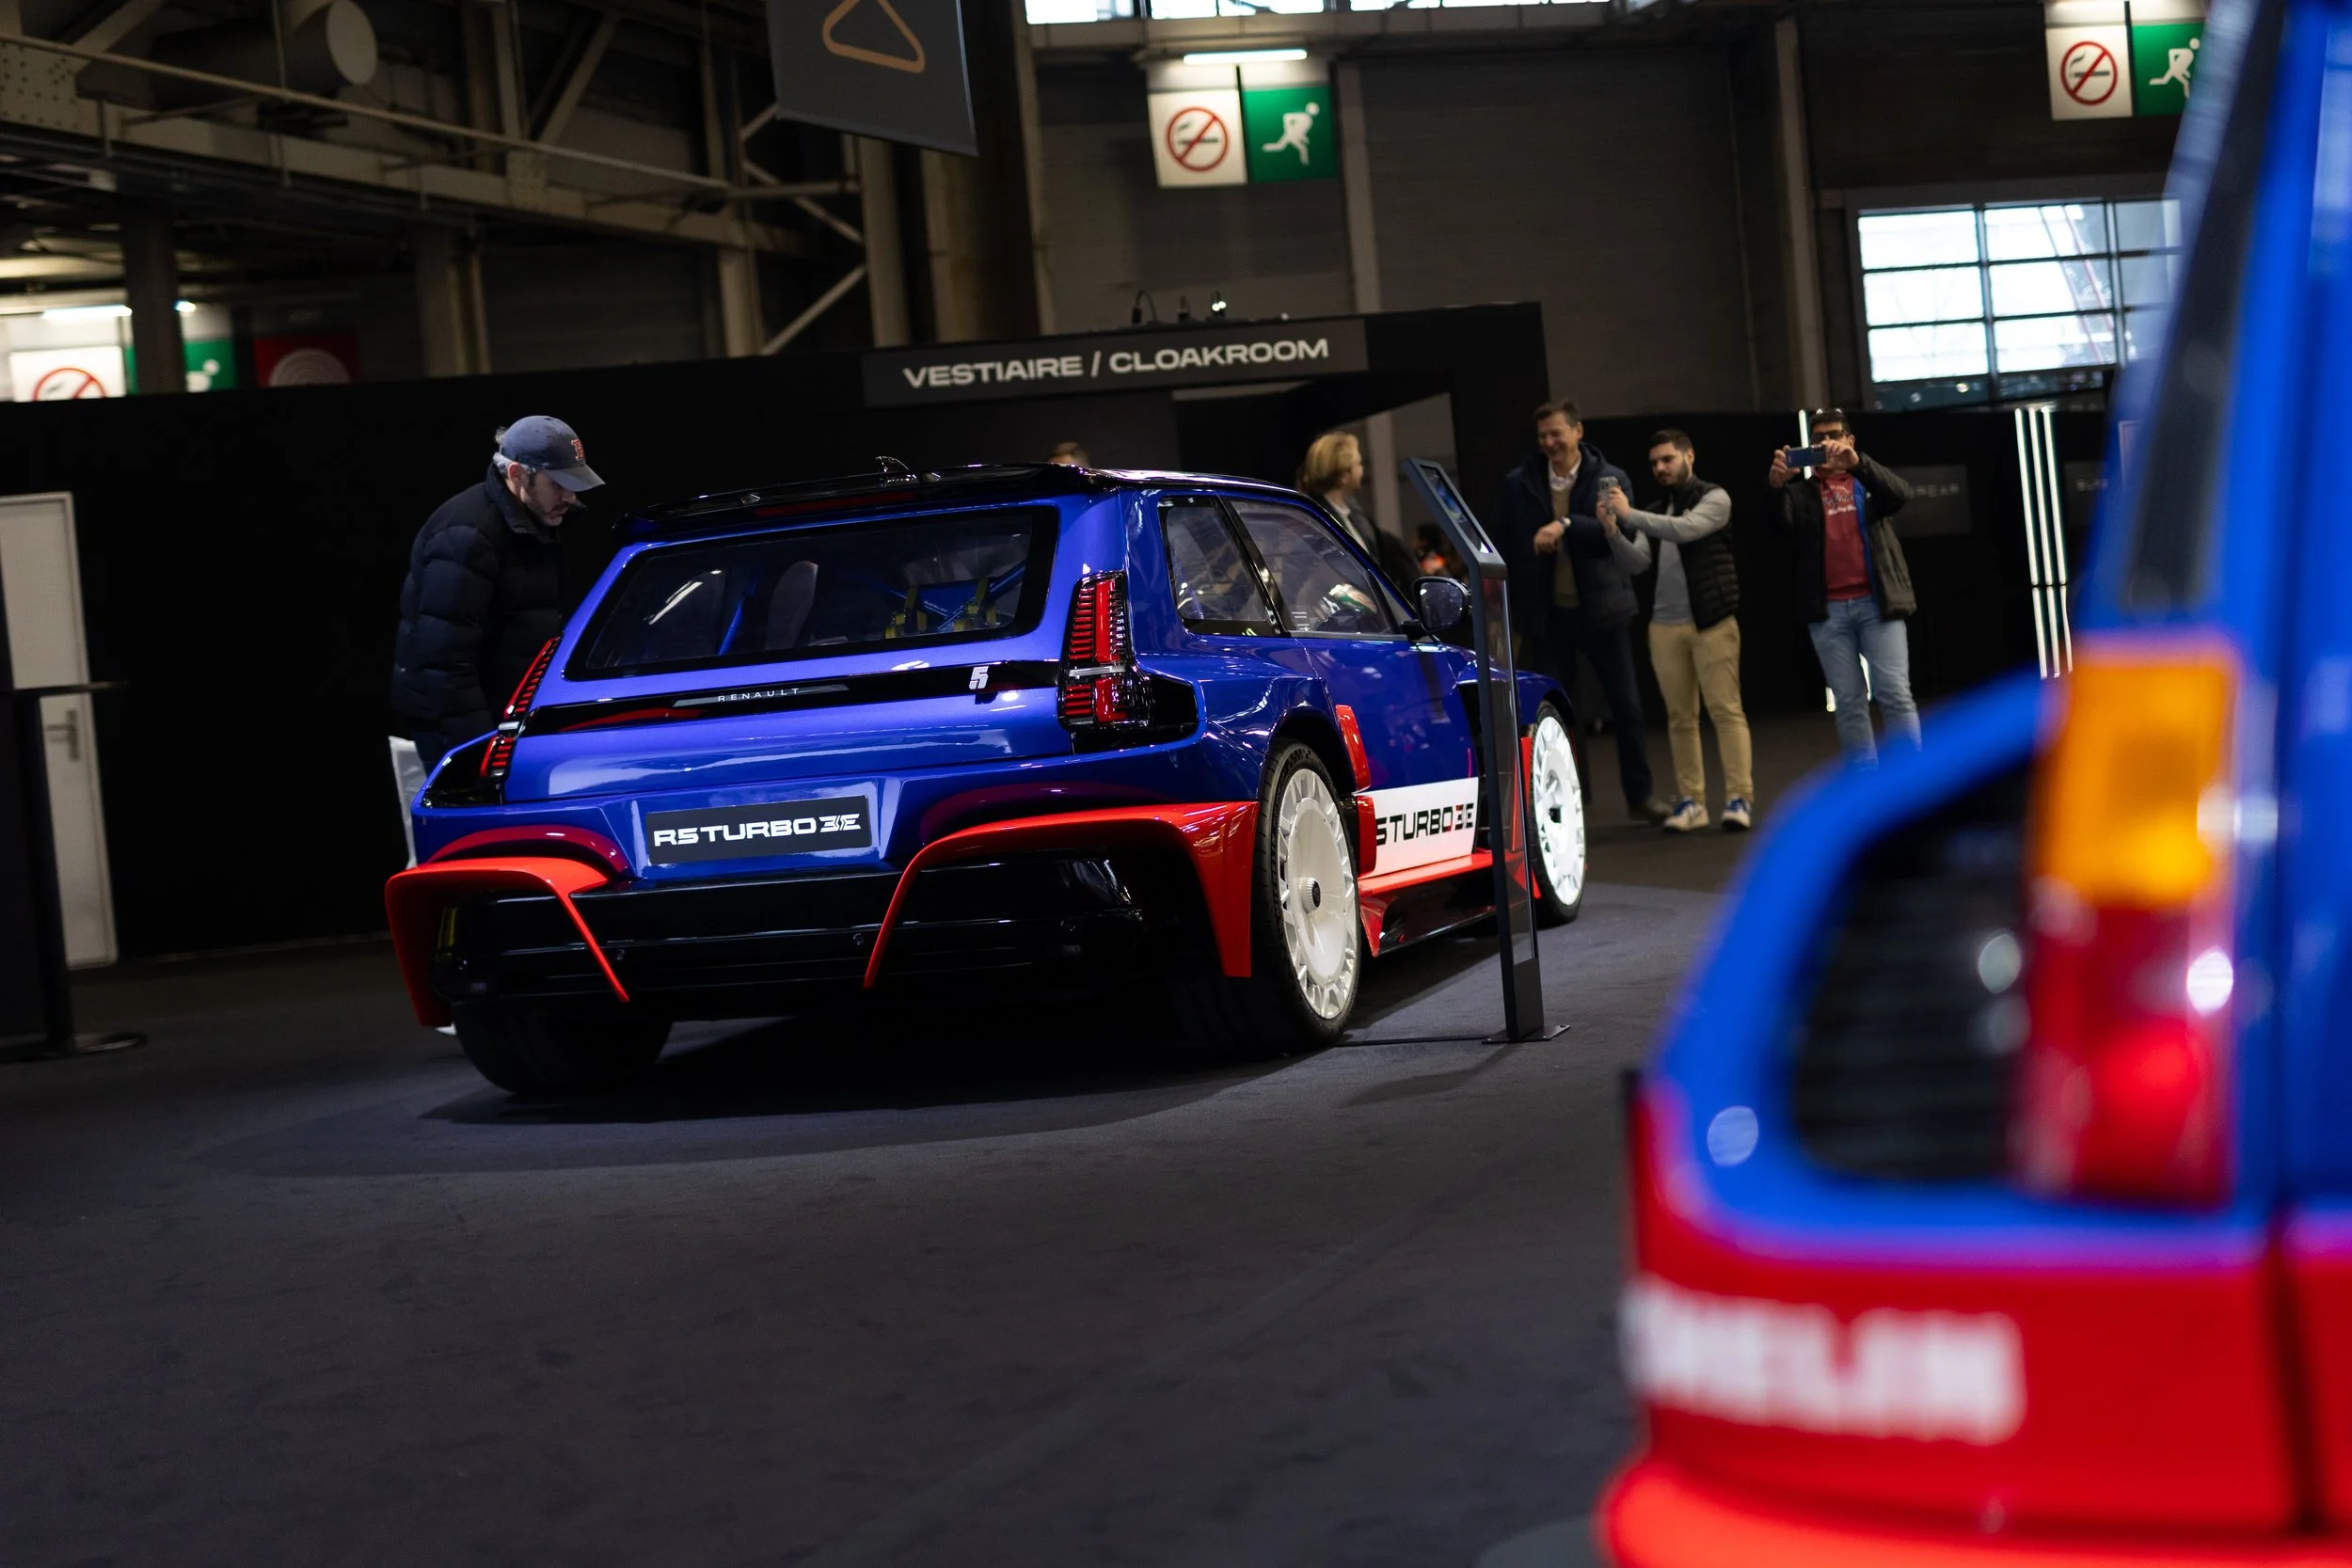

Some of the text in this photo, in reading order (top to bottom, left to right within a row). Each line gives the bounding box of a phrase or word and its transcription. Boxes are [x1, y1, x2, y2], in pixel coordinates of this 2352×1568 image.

[902, 338, 1329, 388] VESTIAIRE / CLOAKROOM
[969, 666, 989, 689] 5
[718, 688, 799, 702] RENAULT
